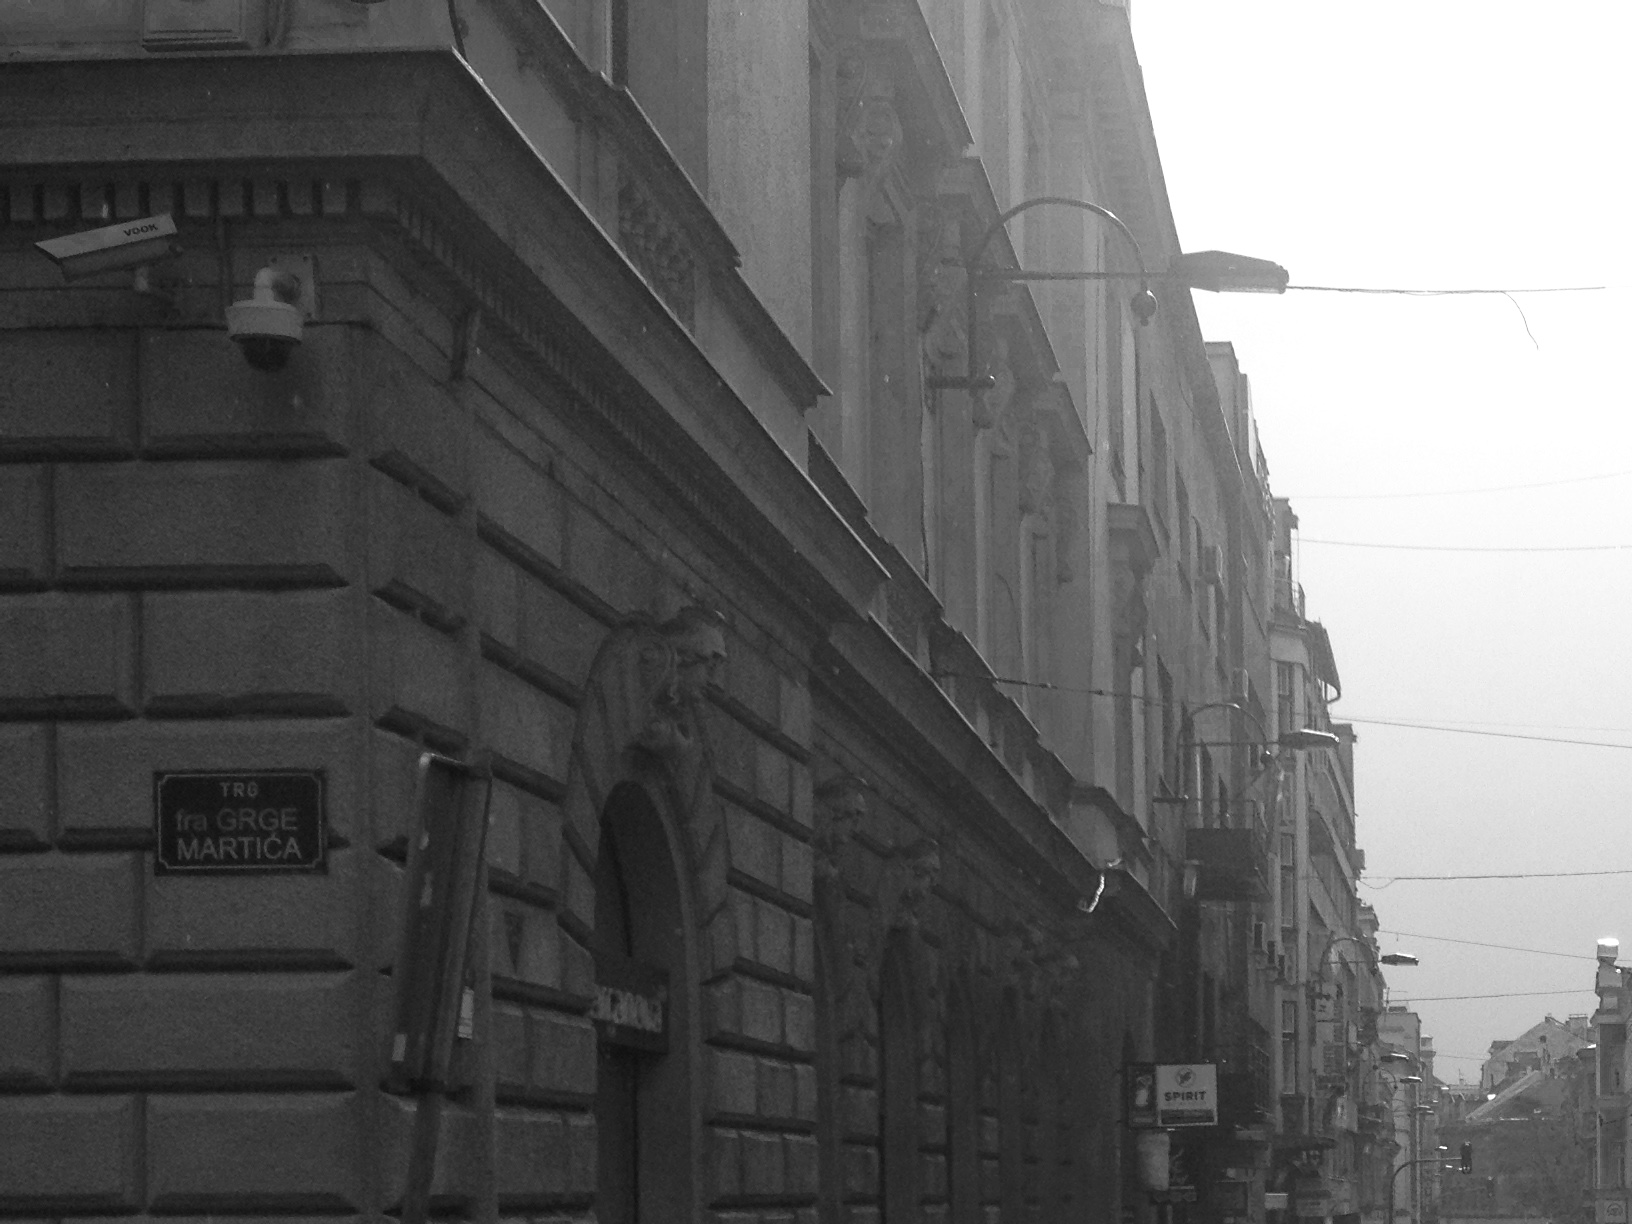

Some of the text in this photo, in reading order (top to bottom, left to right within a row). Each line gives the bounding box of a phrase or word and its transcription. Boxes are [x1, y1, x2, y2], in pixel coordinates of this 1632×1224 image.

[219, 781, 259, 798] TRG
[175, 807, 299, 832] fra GRGE
[176, 831, 303, 861] MARTIĆA
[1164, 1091, 1206, 1102] SPIRIT
